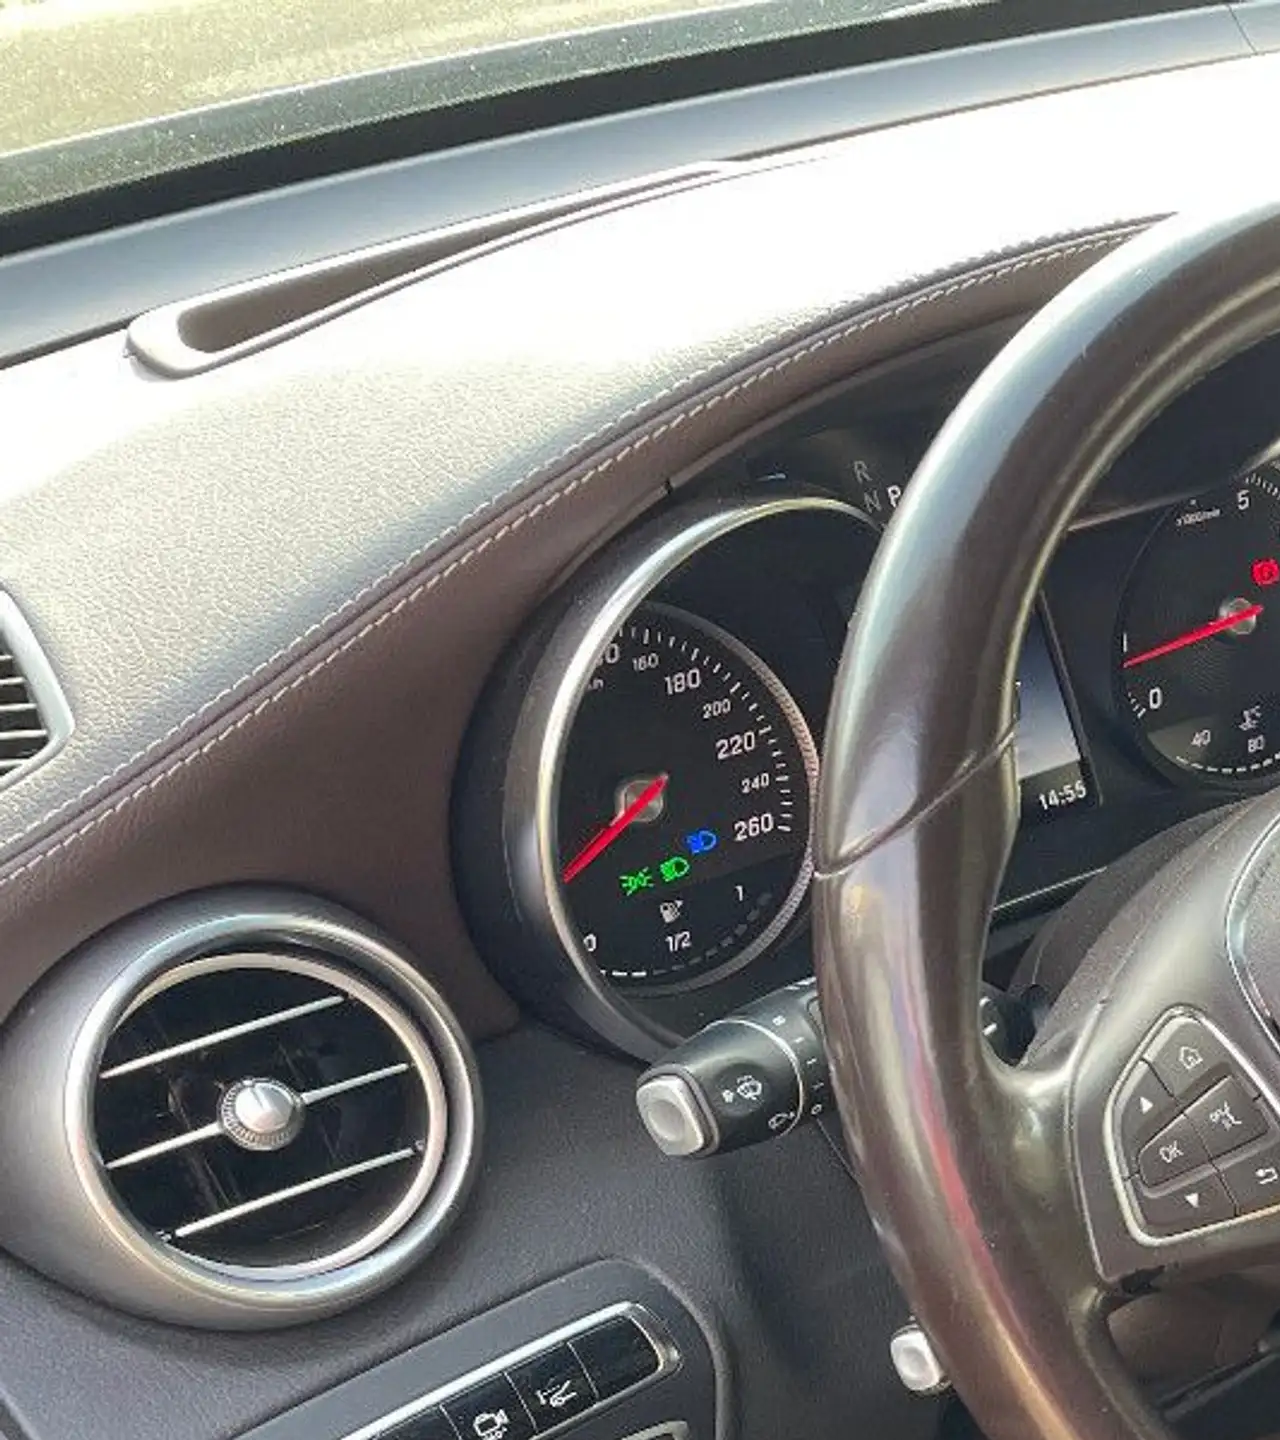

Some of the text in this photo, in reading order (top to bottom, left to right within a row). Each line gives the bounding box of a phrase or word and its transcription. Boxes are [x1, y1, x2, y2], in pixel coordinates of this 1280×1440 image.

[853, 460, 872, 484] R
[887, 485, 901, 508] P
[1236, 489, 1250, 510] 5
[632, 652, 659, 672] 160
[664, 668, 701, 696] 180
[702, 698, 732, 719] 200
[1149, 687, 1163, 710] 0
[715, 731, 756, 761] 220
[1247, 734, 1265, 754] 80
[741, 772, 770, 794] 240
[1038, 779, 1087, 811] 14:55
[734, 812, 774, 843] 260
[734, 884, 745, 902] 1
[583, 933, 597, 953] 0
[666, 931, 693, 953] 1/2
[1158, 1140, 1185, 1164] OK
